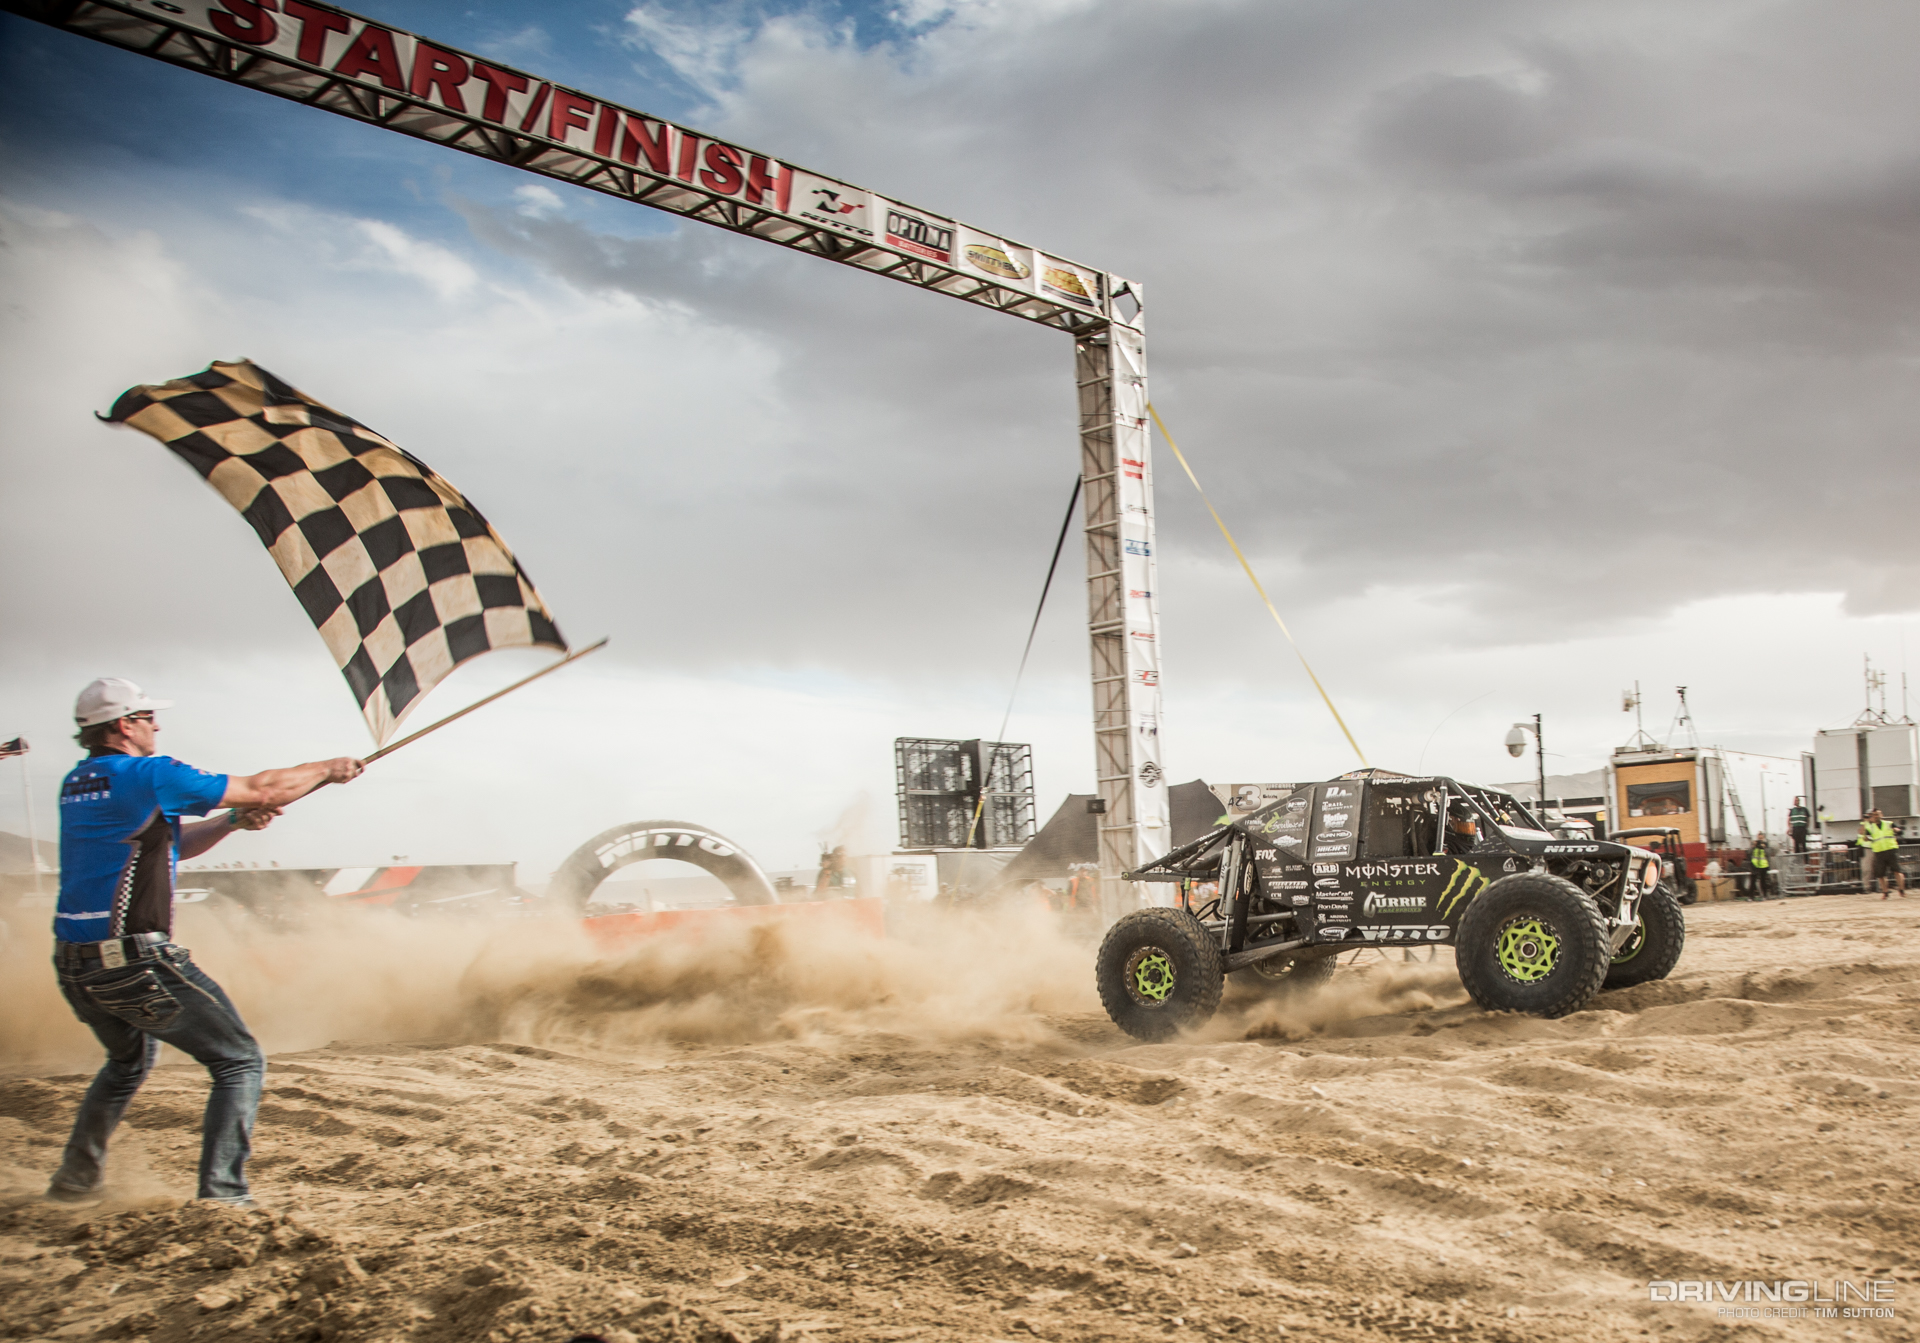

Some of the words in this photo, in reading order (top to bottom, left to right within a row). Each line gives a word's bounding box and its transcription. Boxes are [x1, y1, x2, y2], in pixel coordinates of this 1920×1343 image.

[889, 214, 950, 251] OPTIMA
[1255, 849, 1277, 862] FOX
[1543, 845, 1600, 853] NITTO
[1316, 864, 1337, 874] ARB
[1345, 863, 1441, 879] MONSTER
[1363, 891, 1427, 918] CURRIE
